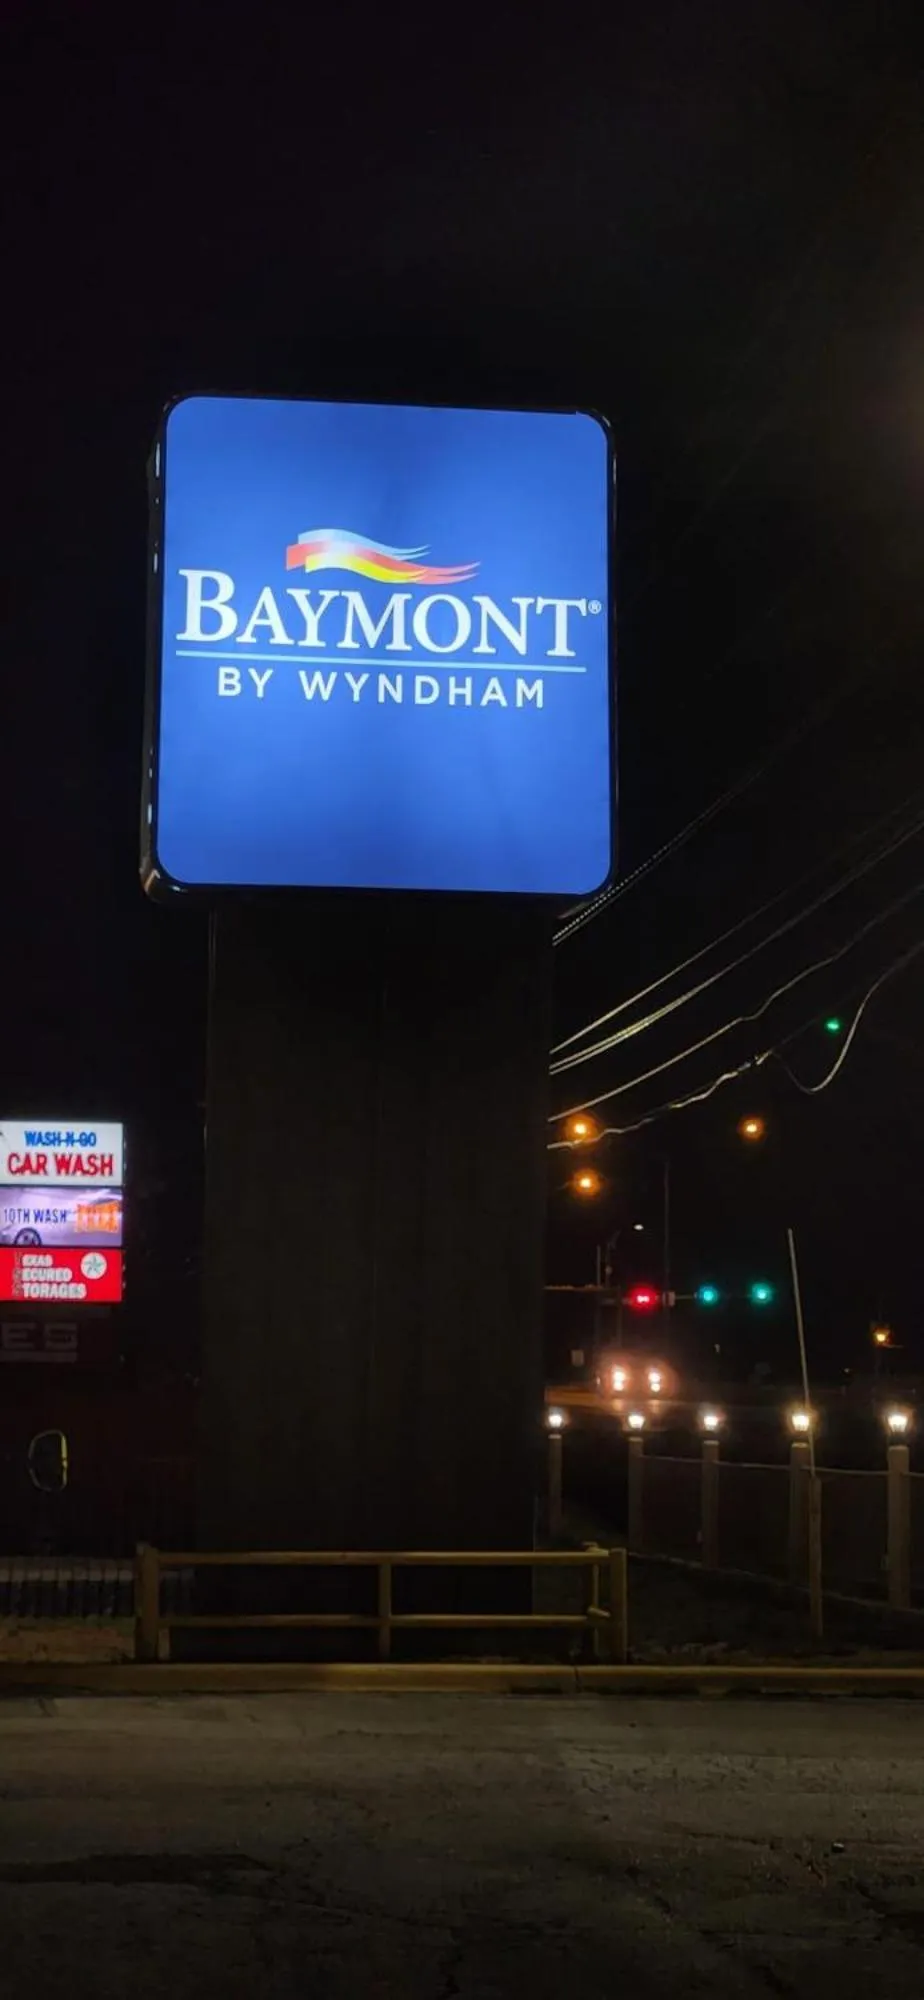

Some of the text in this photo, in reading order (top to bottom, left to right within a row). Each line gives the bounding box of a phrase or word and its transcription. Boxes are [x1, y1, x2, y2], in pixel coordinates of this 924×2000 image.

[218, 667, 544, 709] BY WYNDHAM
[8, 1152, 114, 1177] CAR WASH
[4, 1208, 30, 1224] 10TH
[34, 1208, 68, 1224] WASH
